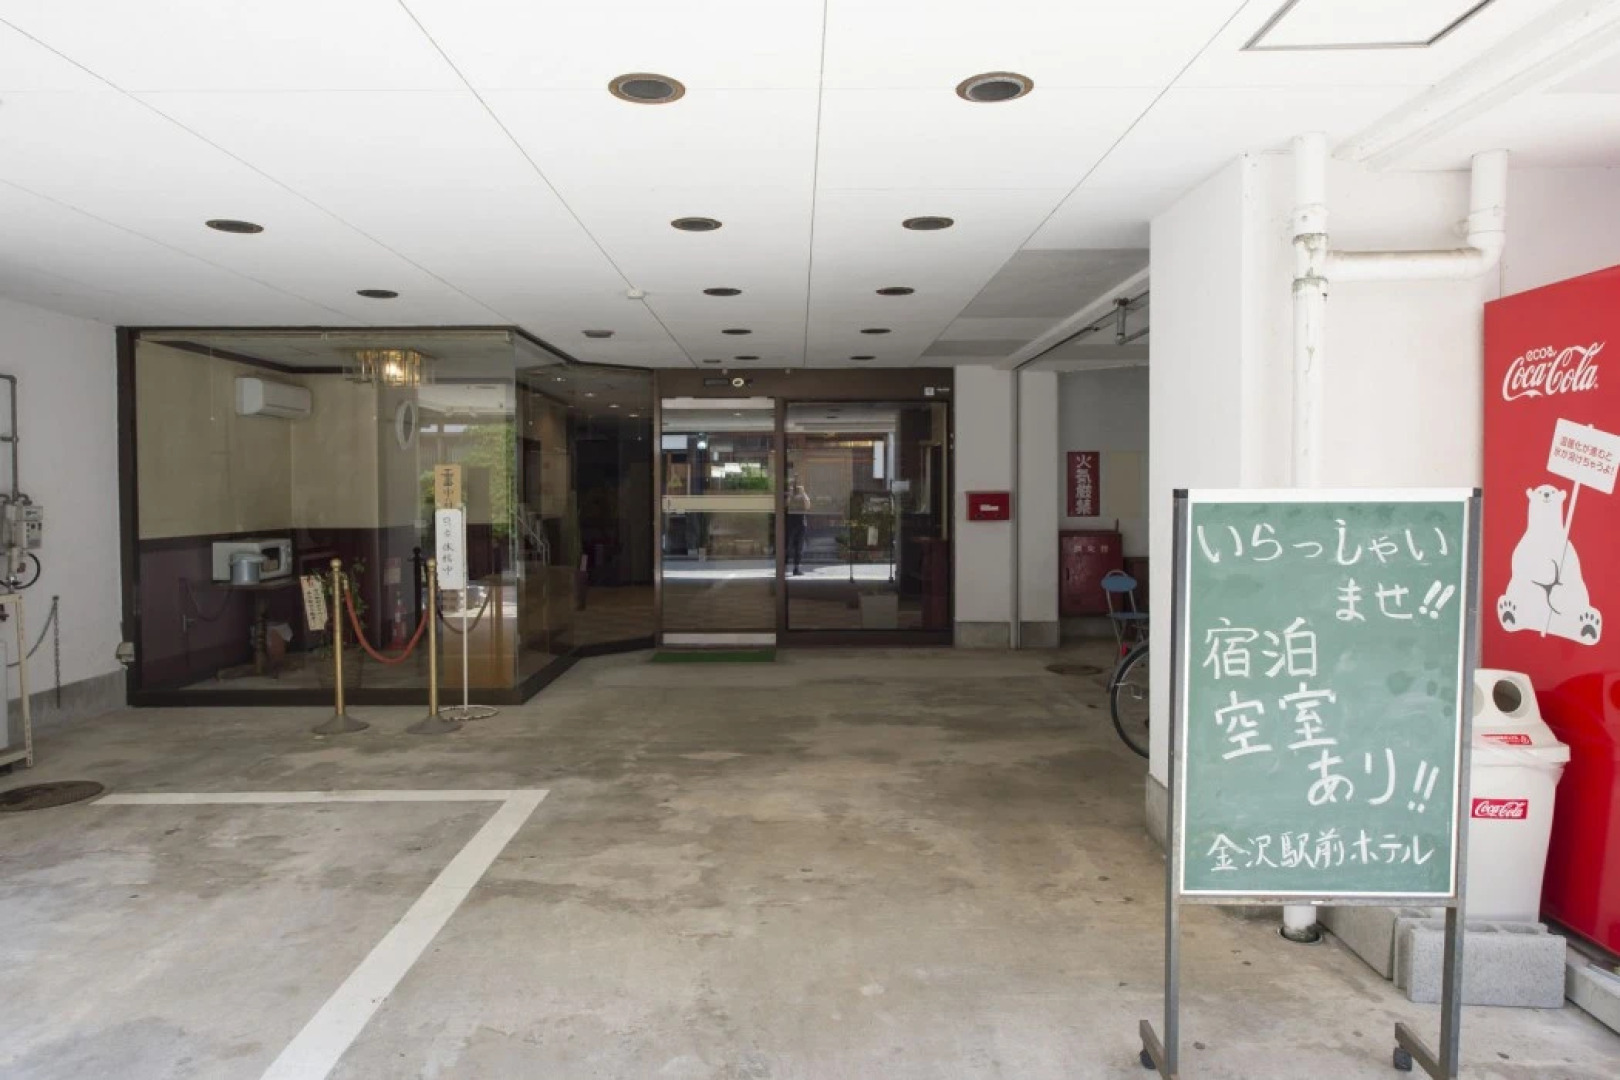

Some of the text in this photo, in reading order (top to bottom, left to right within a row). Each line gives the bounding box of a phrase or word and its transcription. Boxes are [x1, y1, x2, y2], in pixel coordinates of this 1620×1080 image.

[1502, 341, 1606, 401] Coca-Cola
[1197, 519, 1449, 566] いらっしゃい
[1202, 616, 1318, 680] 宿泊
[1214, 682, 1339, 760] 空室
[1474, 800, 1526, 818] Coca-Cola
[1206, 827, 1435, 872] 金沢駅前ホテル
